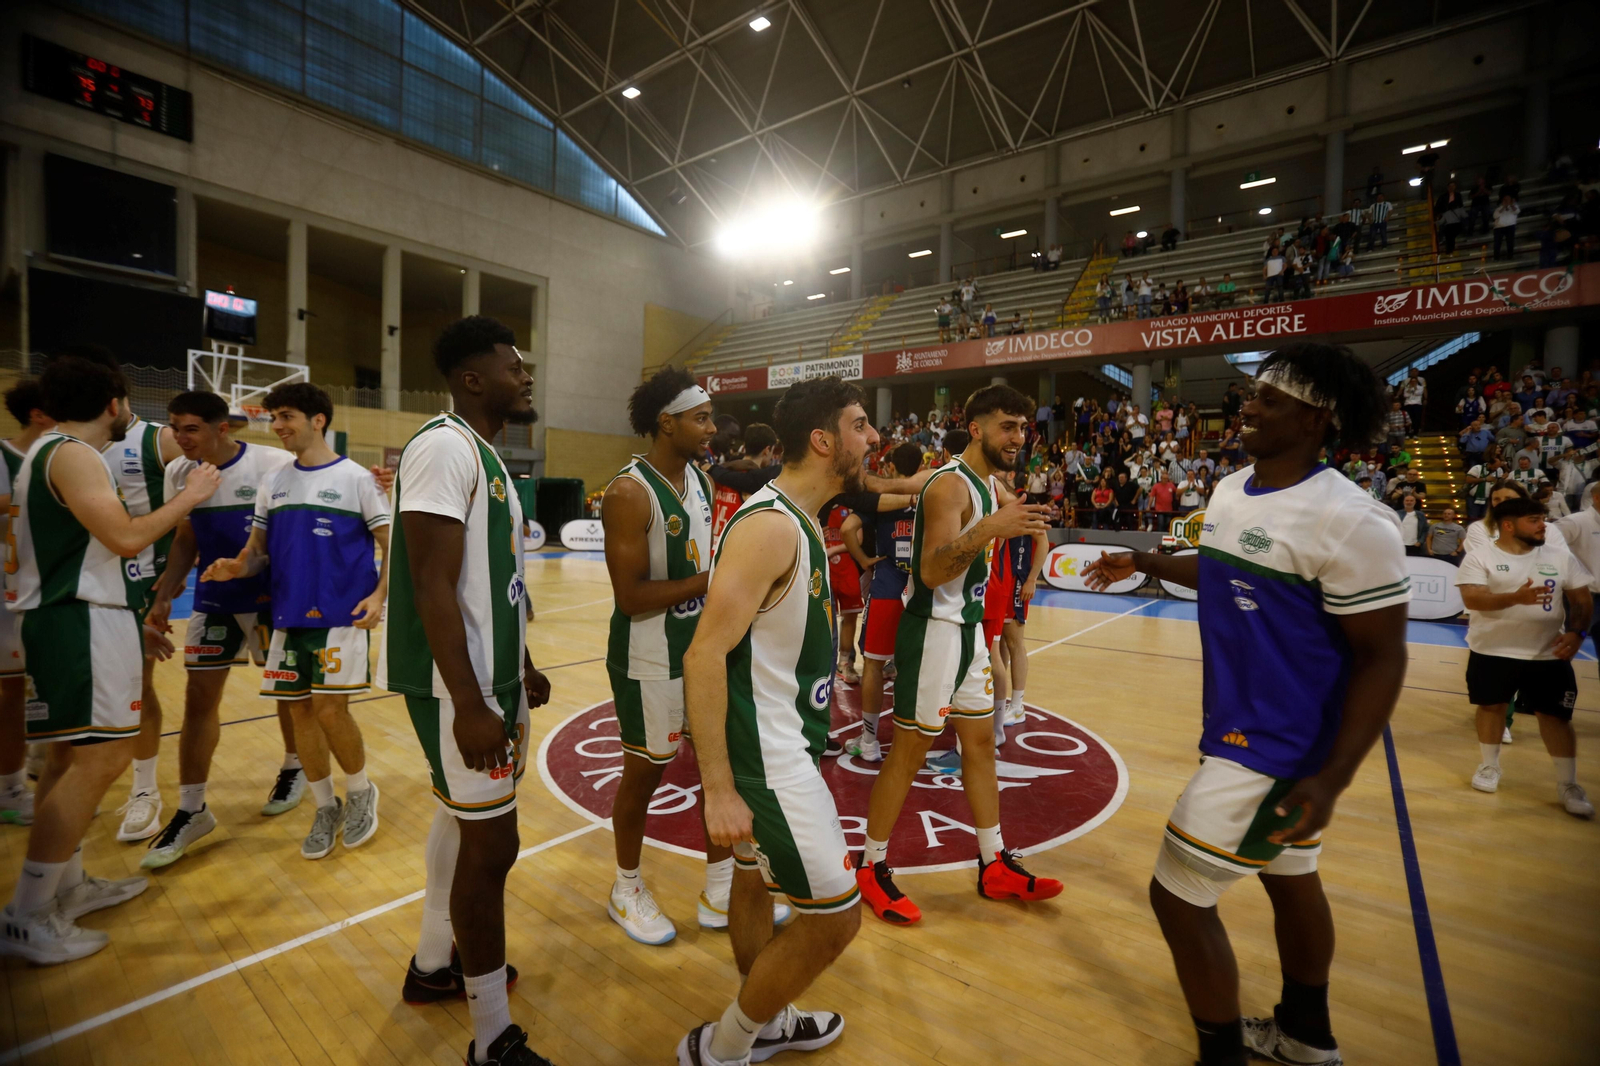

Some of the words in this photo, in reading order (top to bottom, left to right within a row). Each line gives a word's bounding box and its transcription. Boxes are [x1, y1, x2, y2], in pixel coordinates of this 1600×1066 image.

[1416, 271, 1574, 310] IMDECO
[1150, 317, 1189, 328] PALACIO
[1190, 311, 1241, 324] MUNICIPAL
[1243, 305, 1293, 318] DEPORTES
[1374, 316, 1410, 326] Instituto
[1412, 309, 1457, 322] Municipal
[1460, 308, 1472, 317] de
[1477, 304, 1521, 315] Deporte
[1008, 328, 1093, 354] IMDECO
[1141, 326, 1202, 348] VISTA
[1209, 314, 1307, 342] ALEGRE
[913, 349, 948, 361] AYUNTAMIENTO
[913, 361, 920, 369] DE
[1007, 354, 1033, 363] Municipal
[1041, 350, 1066, 360] Deportes
[805, 359, 854, 373] PATRIMONIO
[891, 520, 914, 539] JAE
[685, 539, 701, 573] 4
[1416, 579, 1439, 594] TÚ
